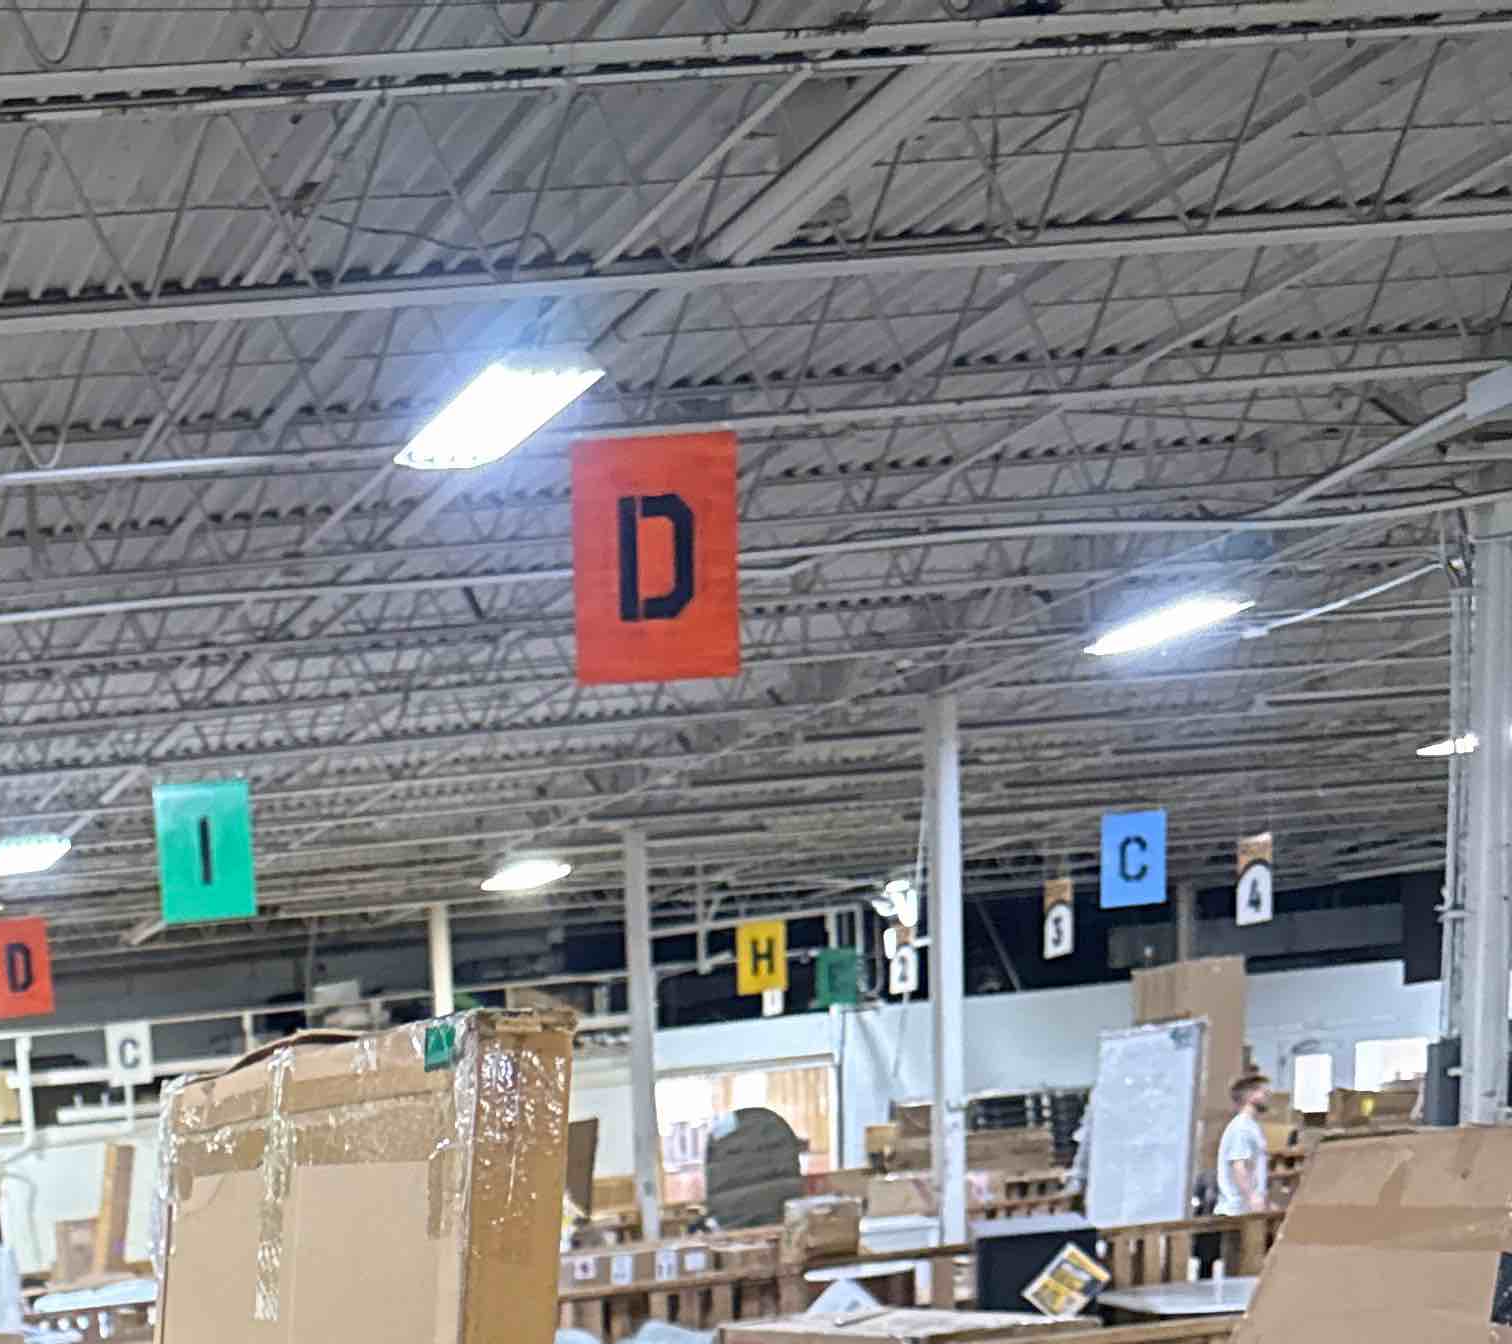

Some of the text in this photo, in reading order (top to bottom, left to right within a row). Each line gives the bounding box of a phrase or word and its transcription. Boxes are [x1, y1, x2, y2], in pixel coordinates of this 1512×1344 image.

[617, 493, 695, 622] D
[198, 815, 214, 887] I
[1117, 835, 1148, 883] C
[1247, 877, 1262, 913] 4
[1051, 915, 1064, 948] 3
[4, 941, 34, 993] D
[750, 937, 776, 977] H
[118, 1037, 142, 1071] C
